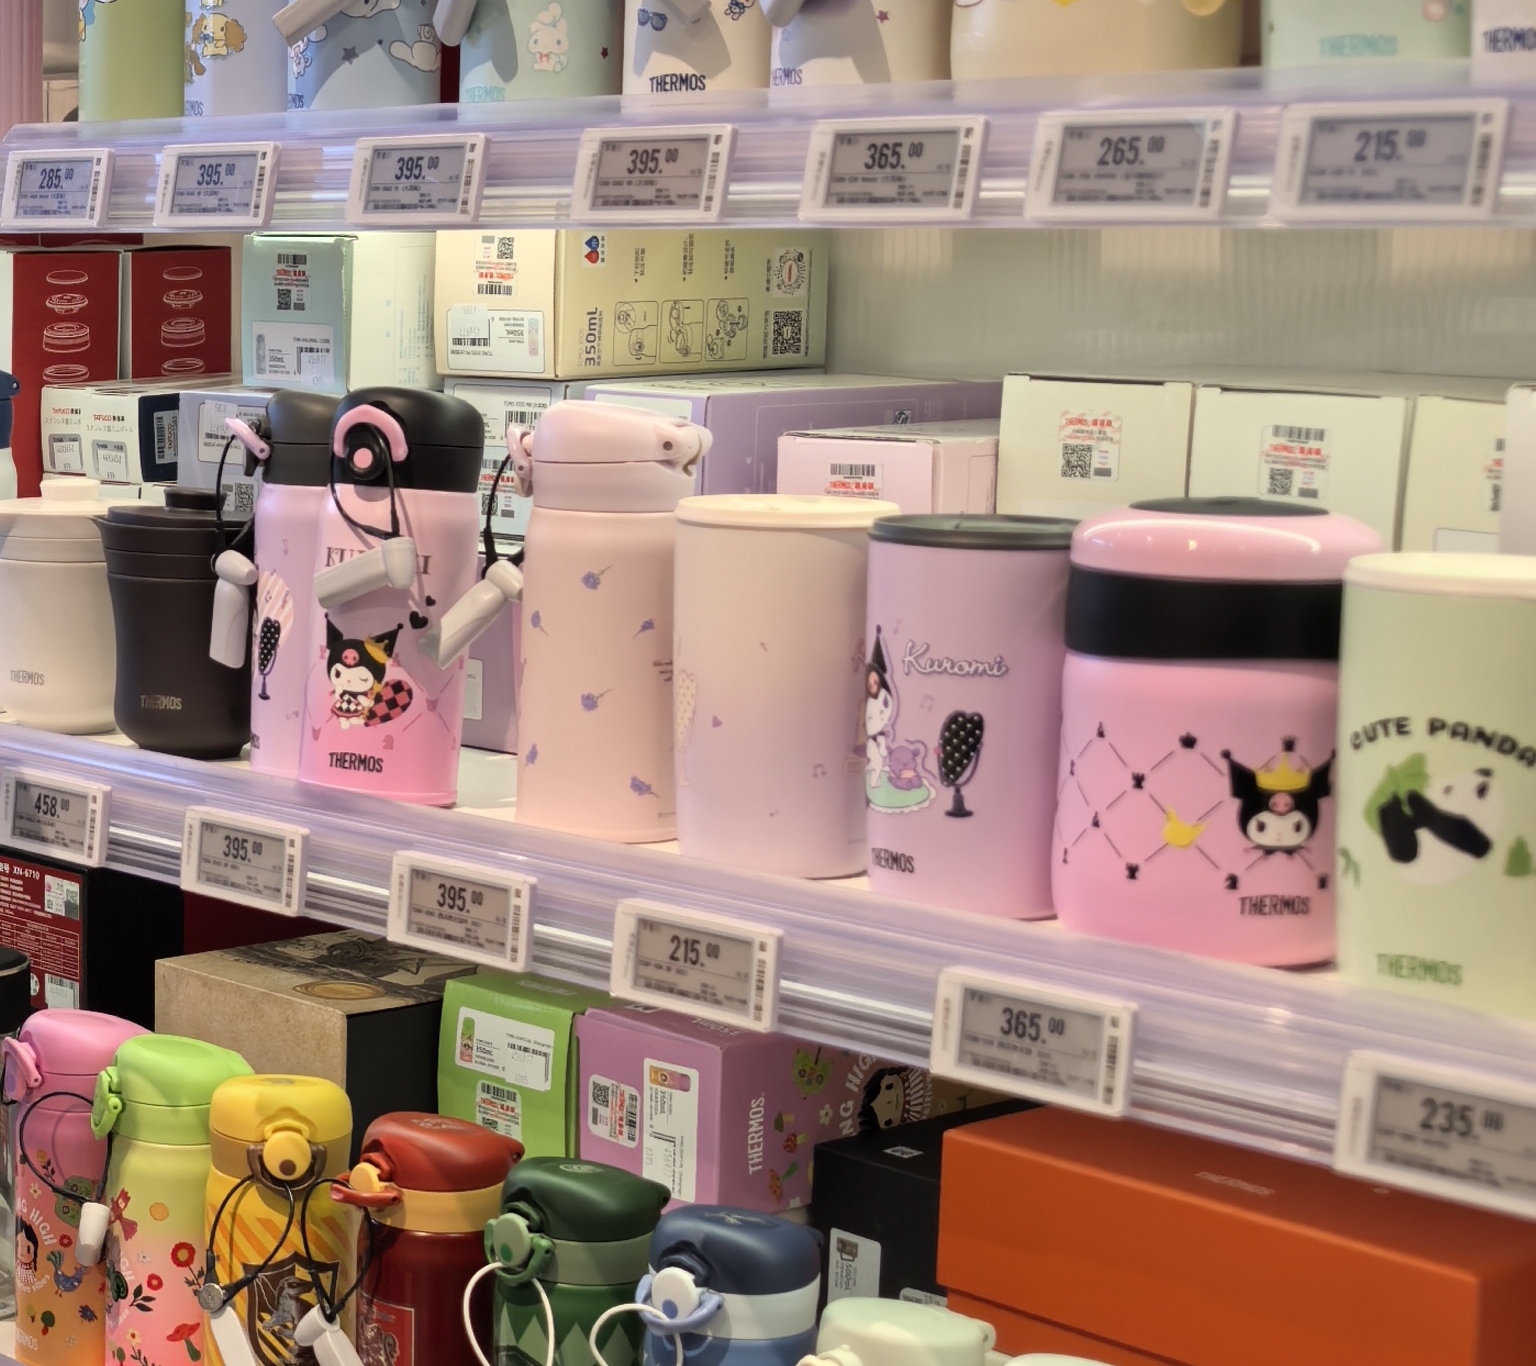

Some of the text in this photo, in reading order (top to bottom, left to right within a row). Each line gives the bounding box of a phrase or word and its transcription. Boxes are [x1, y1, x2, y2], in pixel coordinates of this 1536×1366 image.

[650, 73, 706, 94] THERMOS
[626, 147, 679, 176] 395.00
[864, 141, 924, 170] 365.00
[1097, 135, 1166, 167] 265.00
[39, 166, 74, 191] 285.00
[197, 161, 236, 186] 395.00
[394, 155, 440, 182] 395.00
[584, 307, 598, 367] 350mL
[902, 639, 1009, 678] Kuromi
[10, 669, 45, 687] THERMOS
[139, 693, 183, 711] THERMOS
[1352, 717, 1412, 750] CUTE
[328, 751, 384, 775] THERMOS
[33, 791, 70, 822] 458.00
[222, 834, 264, 864] 395.00
[871, 847, 915, 875] THERMOS
[13, 865, 41, 881] XN-6710
[436, 882, 484, 914] 395.00
[1238, 895, 1311, 917] THERMOS
[668, 934, 721, 968] 215.00
[1375, 954, 1463, 987] THERMOS
[1000, 1007, 1066, 1045] 365.00
[29, 1207, 58, 1246] HIGH
